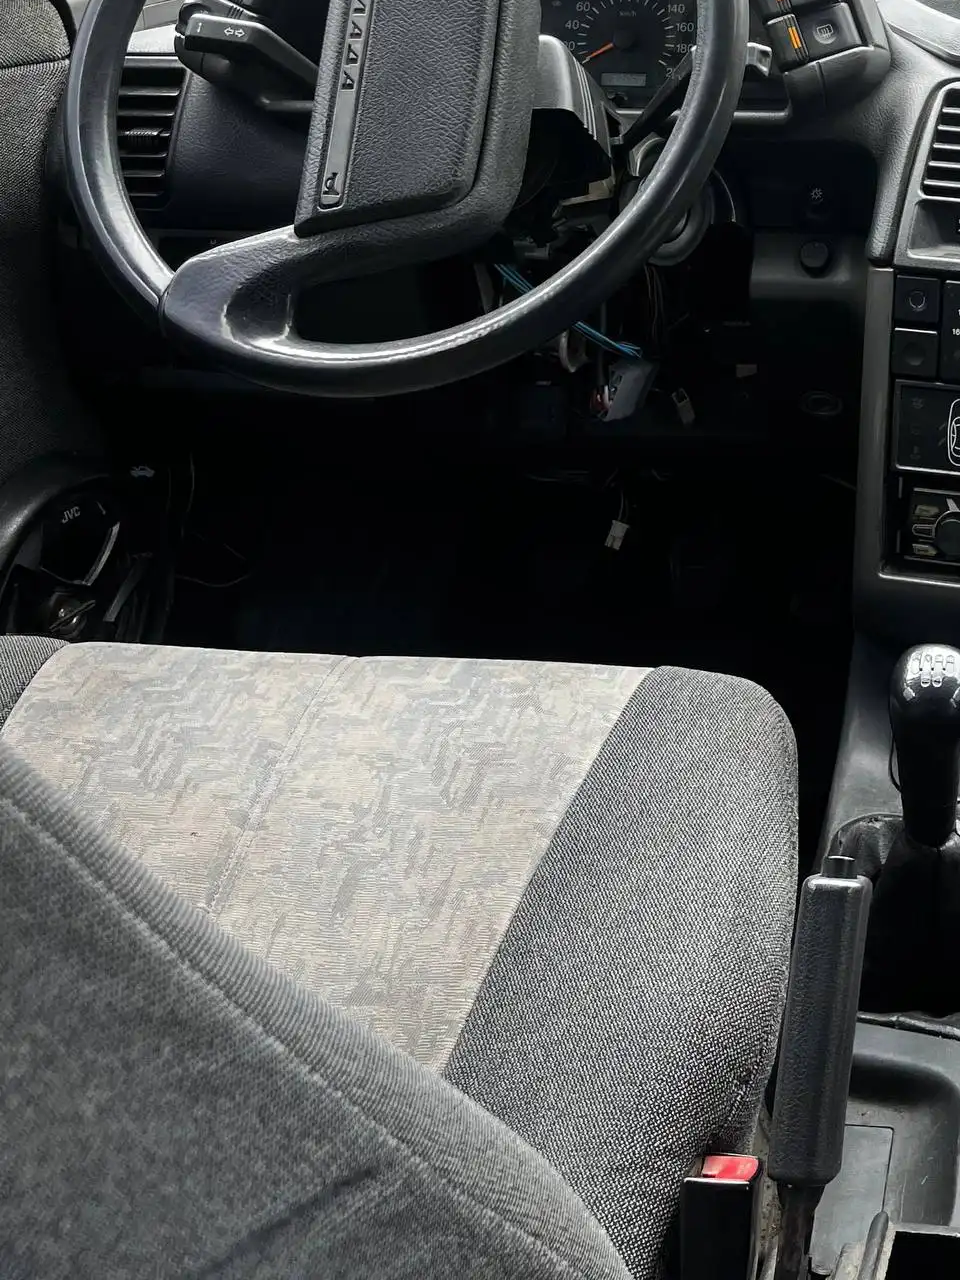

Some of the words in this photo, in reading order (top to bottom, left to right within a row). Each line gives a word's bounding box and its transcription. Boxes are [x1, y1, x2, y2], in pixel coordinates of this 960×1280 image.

[575, 2, 591, 12] 60
[667, 3, 685, 14] 140
[564, 19, 580, 30] 40
[676, 22, 694, 32] 160
[952, 328, 960, 336] 16
[61, 506, 81, 524] JVC
